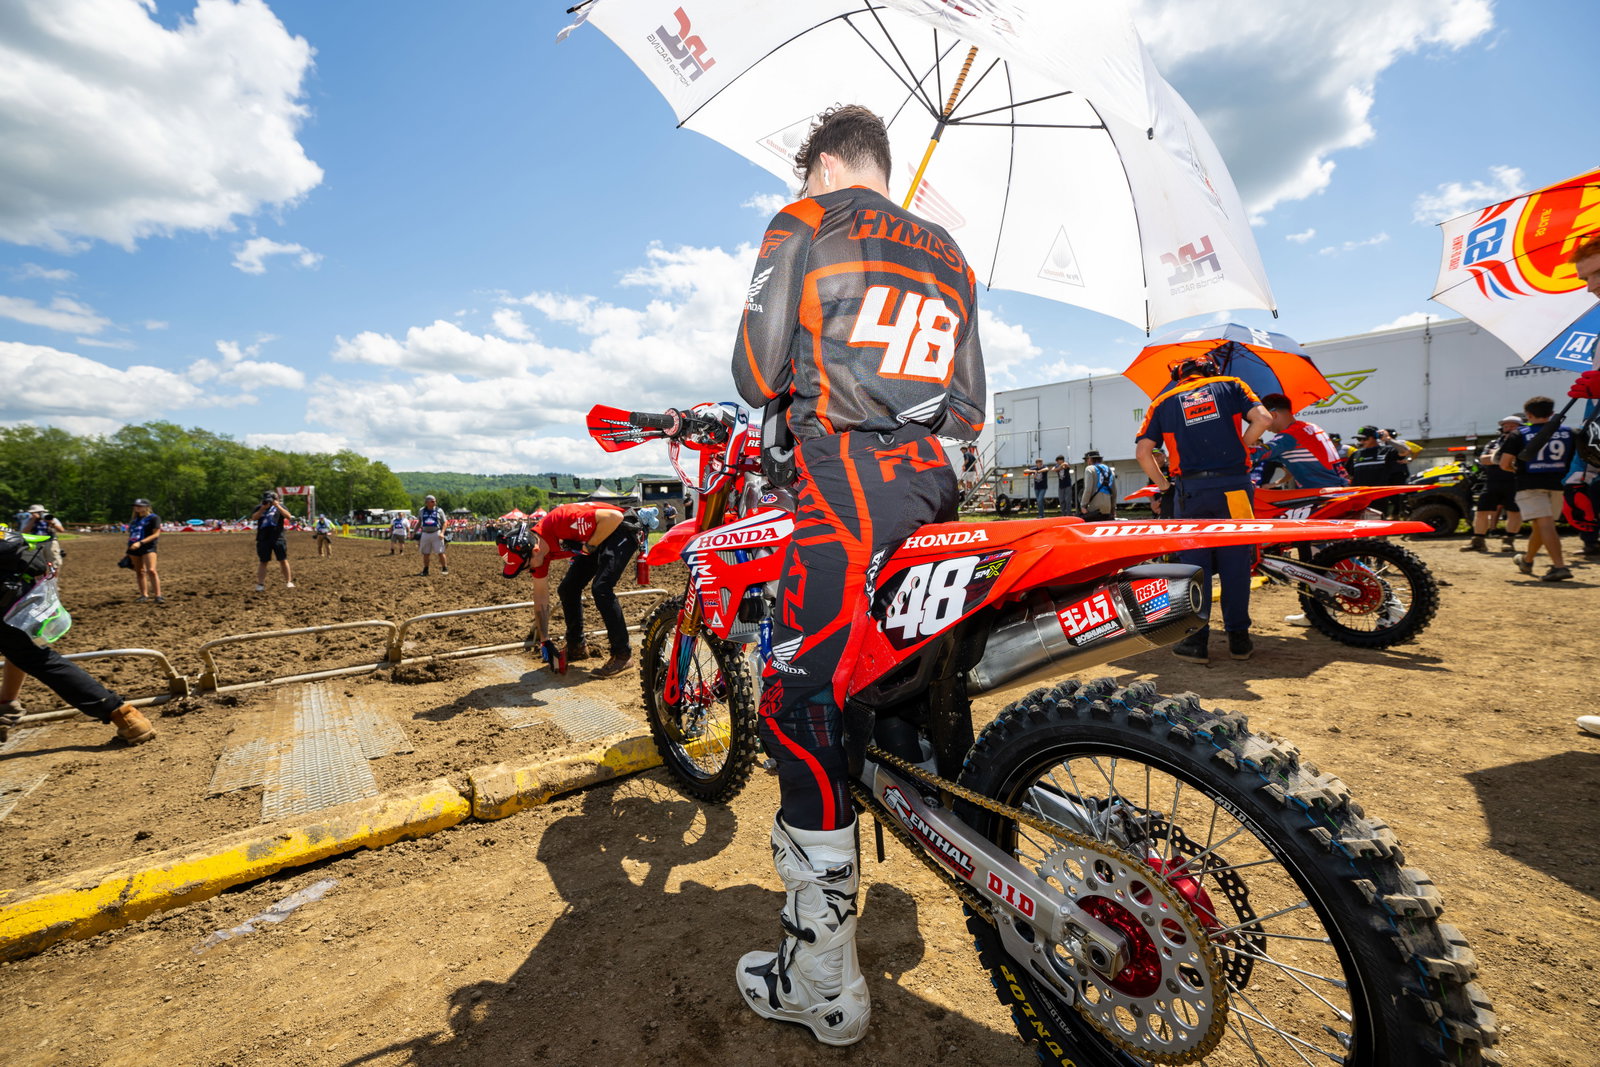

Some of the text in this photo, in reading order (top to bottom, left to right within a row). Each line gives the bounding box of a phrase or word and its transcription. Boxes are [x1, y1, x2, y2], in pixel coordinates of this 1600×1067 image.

[847, 209, 965, 273] HYMAS
[847, 285, 961, 386] 48
[1301, 405, 1369, 417] CHAMPIONSHIP
[746, 439, 762, 448] RE
[1525, 431, 1570, 441] PSS
[697, 527, 779, 549] HONDA
[902, 529, 989, 549] HONDA
[1090, 523, 1274, 538] DUNLOP
[687, 552, 717, 589] CRF
[886, 555, 981, 640] 48
[1061, 594, 1113, 636] ヨシムラ
[1074, 620, 1119, 644] YOSHIMURA
[771, 660, 808, 675] HONDA
[988, 871, 1035, 918] D.I.D
